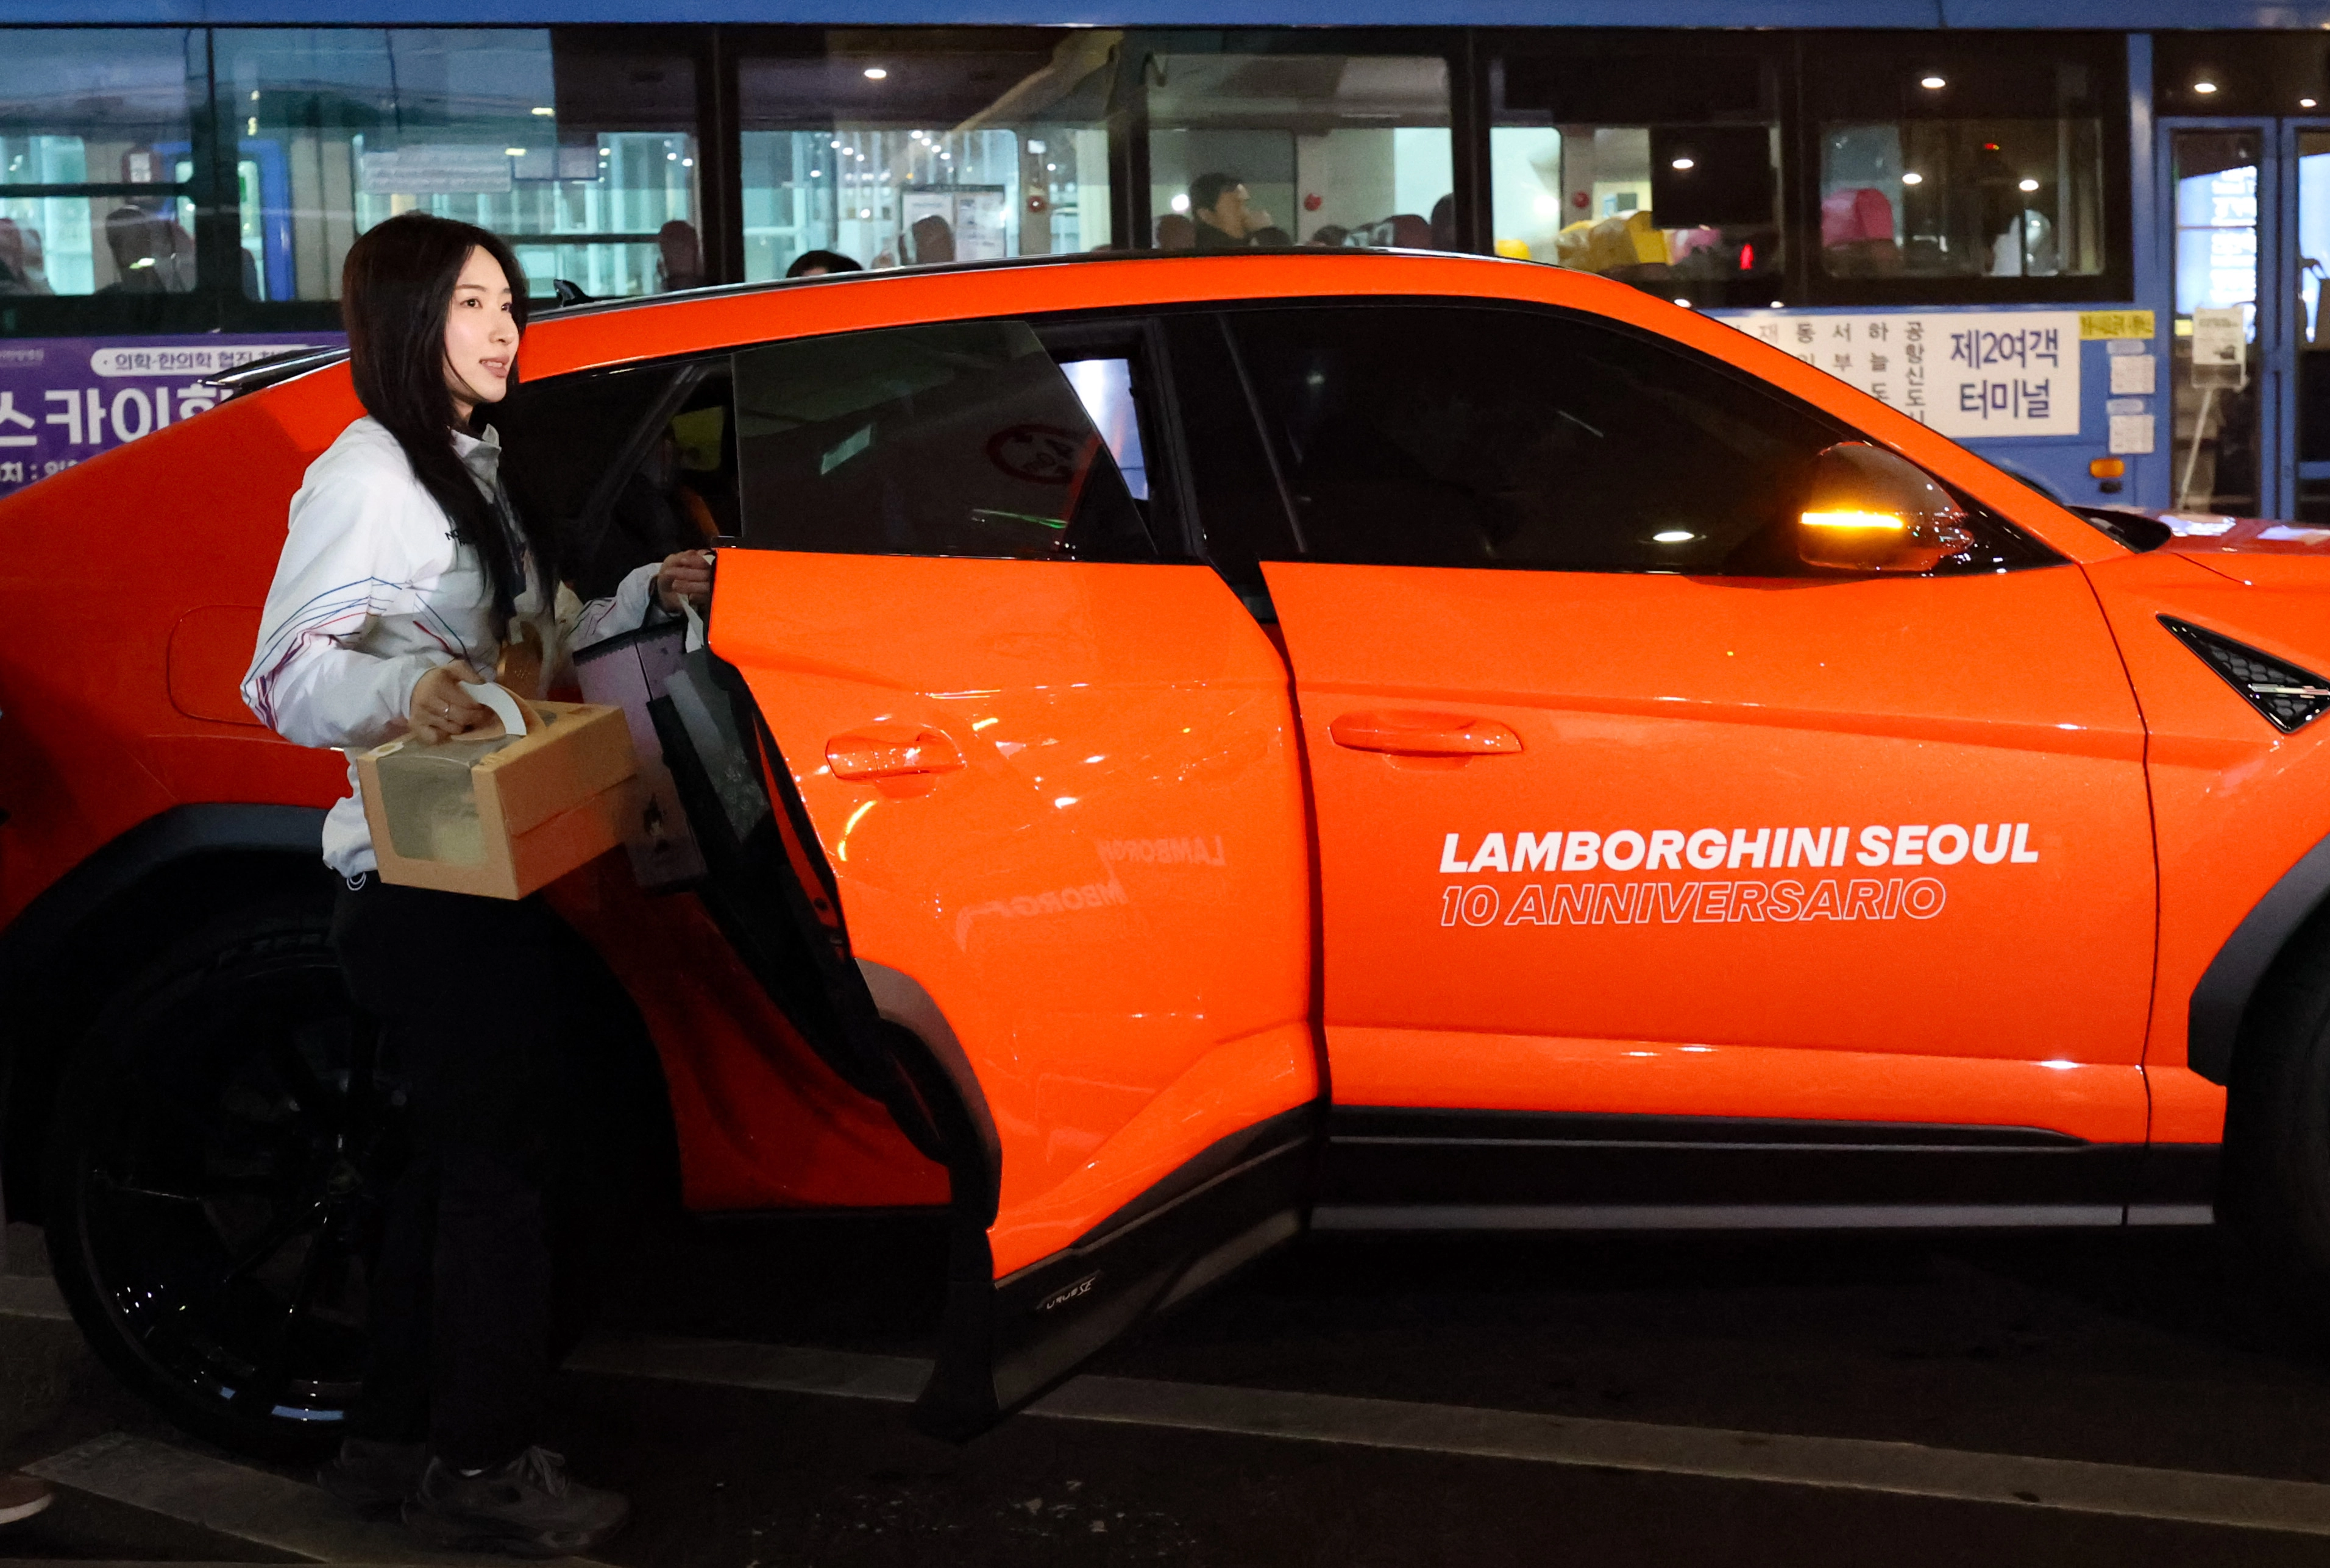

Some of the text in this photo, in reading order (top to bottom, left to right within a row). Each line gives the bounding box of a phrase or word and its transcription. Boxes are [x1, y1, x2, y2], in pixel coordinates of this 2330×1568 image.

[1950, 328, 2058, 369] 제2여객
[1960, 378, 2049, 419] 터미널
[1439, 823, 2039, 873] LAMBORGHINI SEOUL
[1441, 877, 1946, 927] 10 ANNIVERSARIO
